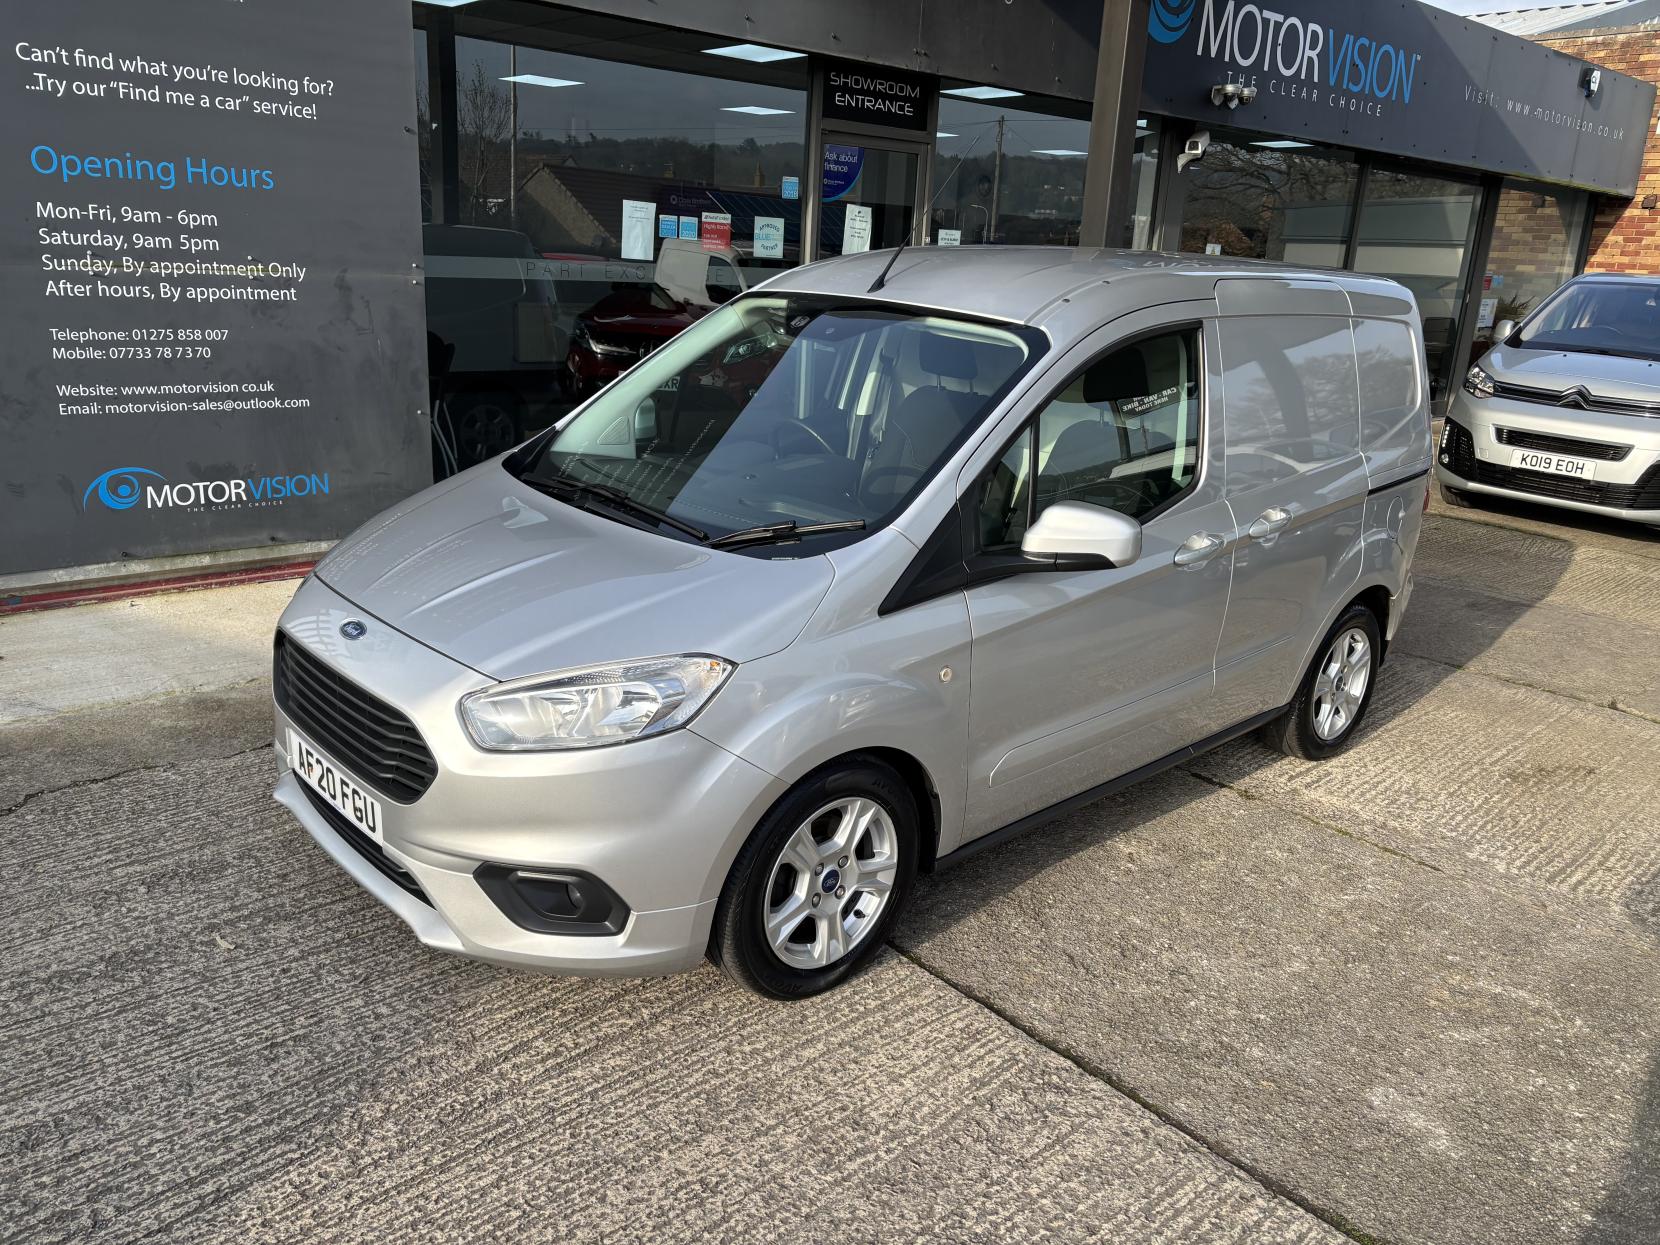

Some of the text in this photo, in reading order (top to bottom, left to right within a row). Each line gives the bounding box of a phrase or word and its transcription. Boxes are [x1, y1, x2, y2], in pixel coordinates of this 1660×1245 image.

[73, 48, 114, 70] find
[119, 56, 169, 77] what
[233, 68, 299, 95] looking
[302, 76, 334, 96] for?
[829, 72, 920, 98] SHOWROOM
[72, 81, 107, 97] our
[166, 90, 195, 106] me
[199, 94, 211, 108] a
[252, 101, 317, 120] service!
[835, 92, 914, 116] ENTRANCE
[1269, 79, 1319, 102] CLEAR
[1329, 94, 1382, 117] CHOICE
[30, 145, 275, 190] Opening Hours
[824, 151, 858, 164] Ask about
[36, 202, 117, 224] Mon-Fri,
[120, 205, 161, 224] 9am
[177, 210, 218, 229] 6pm
[38, 228, 219, 254] Saturday, 9am 5pm
[41, 254, 306, 283] Sunday, By appointment Only
[525, 261, 587, 280] PART
[45, 280, 297, 303] After hours, By appointment
[49, 328, 229, 343] Telephone: 01275 858 007
[52, 347, 107, 360] Mobile:
[109, 347, 152, 359] 07733
[56, 383, 118, 397] Website:
[59, 397, 310, 415] Email: motorvision-sales@outlook.com
[1555, 459, 1585, 475] EOH
[211, 503, 243, 511] CLEAR
[248, 500, 284, 508] CHOICE
[298, 741, 377, 834] AF20 FGU
